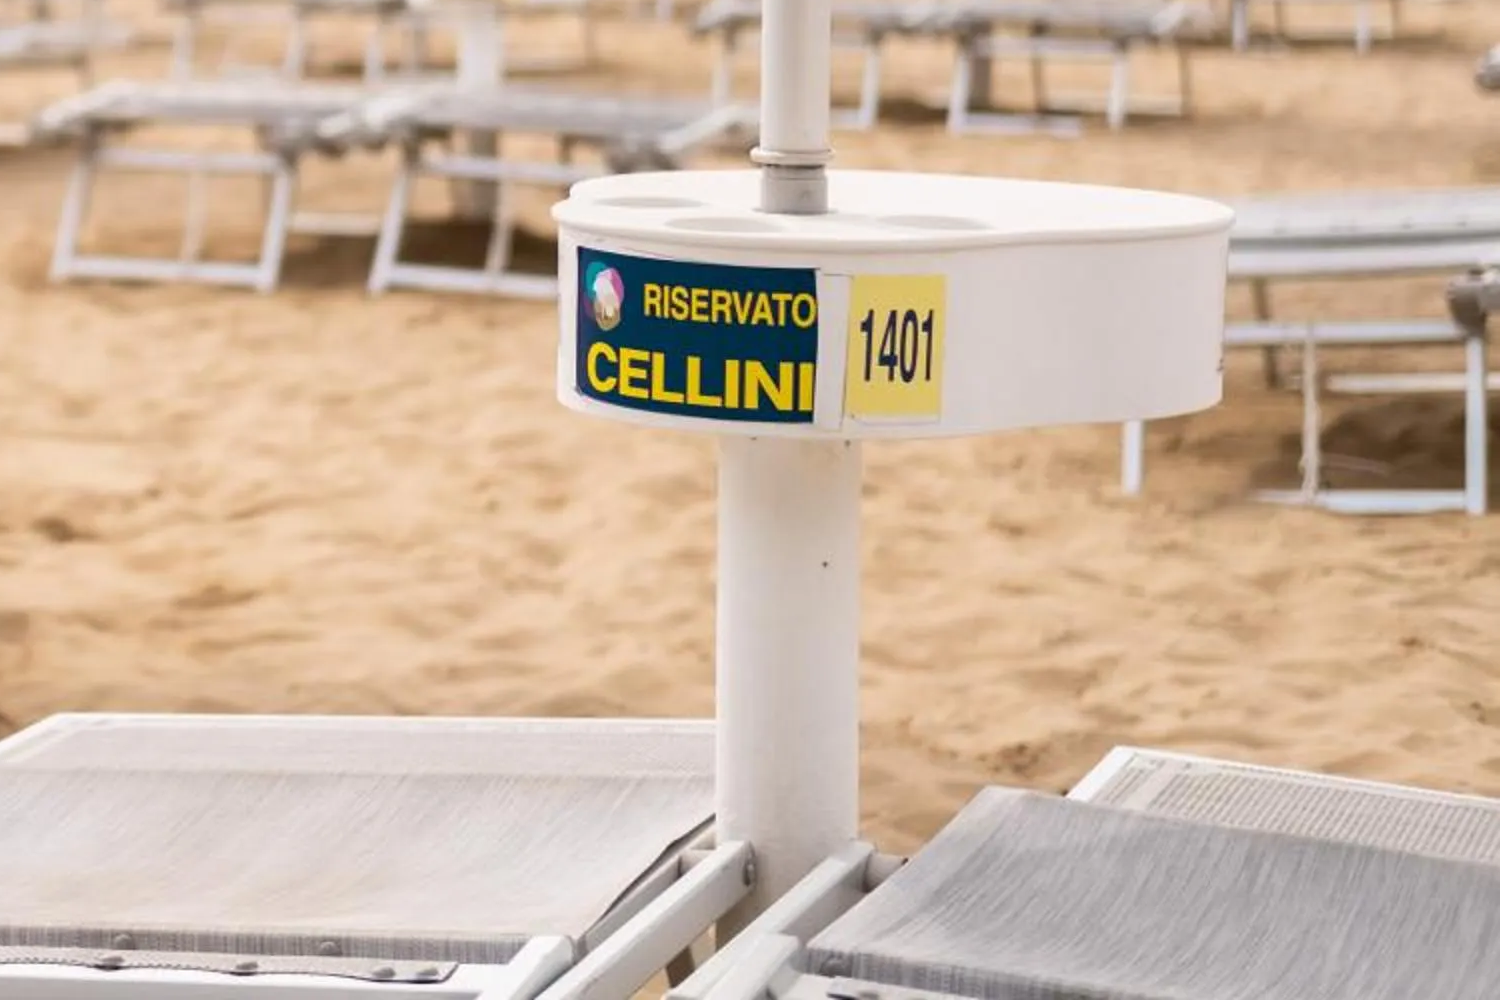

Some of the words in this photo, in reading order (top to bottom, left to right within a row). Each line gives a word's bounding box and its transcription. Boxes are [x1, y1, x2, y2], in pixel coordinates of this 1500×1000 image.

[643, 283, 817, 328] RISERVATO
[586, 341, 814, 412] CELLINI
[860, 308, 933, 383] 1401
